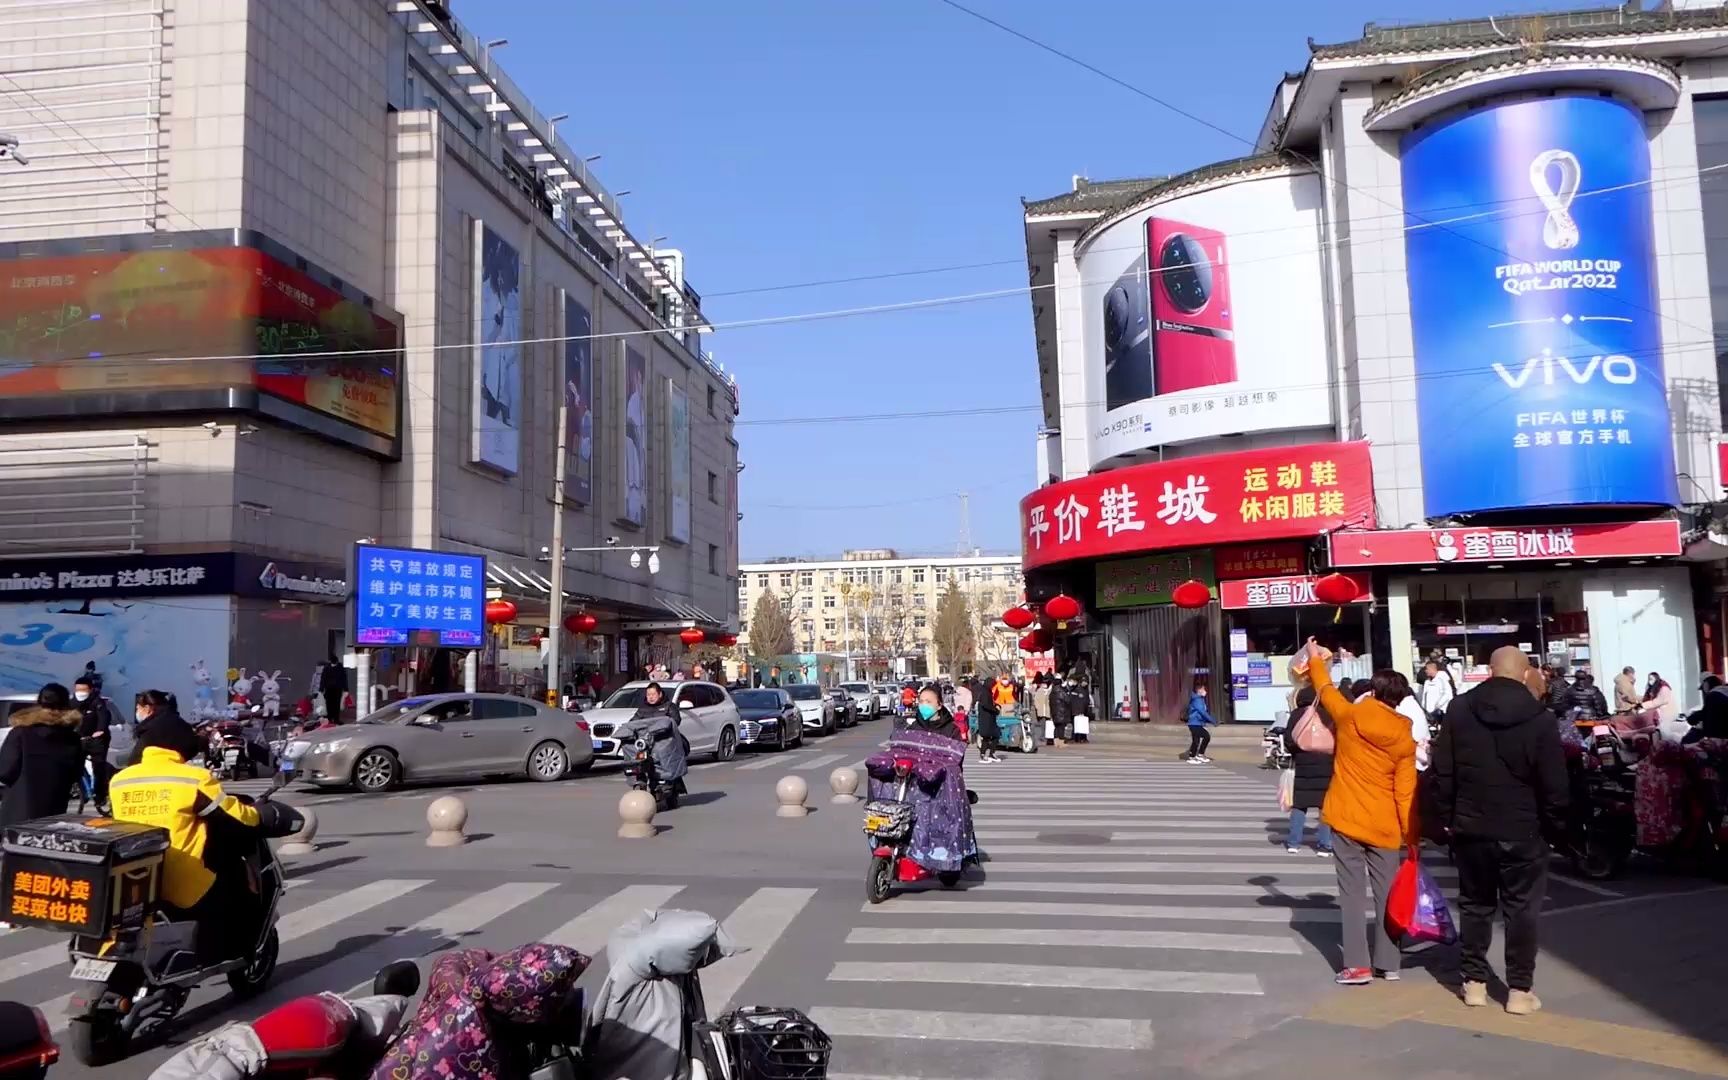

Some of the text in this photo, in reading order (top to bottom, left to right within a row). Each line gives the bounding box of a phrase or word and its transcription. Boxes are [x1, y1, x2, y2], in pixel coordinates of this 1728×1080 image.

[1495, 259, 1622, 279] FIFA WORLD CUP
[1491, 347, 1637, 389] vivo
[1516, 409, 1627, 428] FIFA 世界杯
[1512, 429, 1632, 449] 全球官方手机
[1243, 459, 1338, 493] 运动鞋
[1028, 474, 1218, 550] 平价鞋城
[1239, 490, 1346, 523] 休闲服装
[1462, 527, 1577, 560] 蜜雪冰城
[58, 571, 113, 589] Pizza
[117, 566, 206, 587] 达美乐比萨
[370, 557, 473, 579] 共守禁放规定
[370, 579, 473, 599] 维护城市环境
[1246, 579, 1322, 606] 蜜雪冰
[370, 601, 473, 621] 为了美好生活
[122, 788, 172, 804] 美团外卖
[14, 871, 91, 900] 美团外卖
[12, 895, 88, 924] 买菜也快
